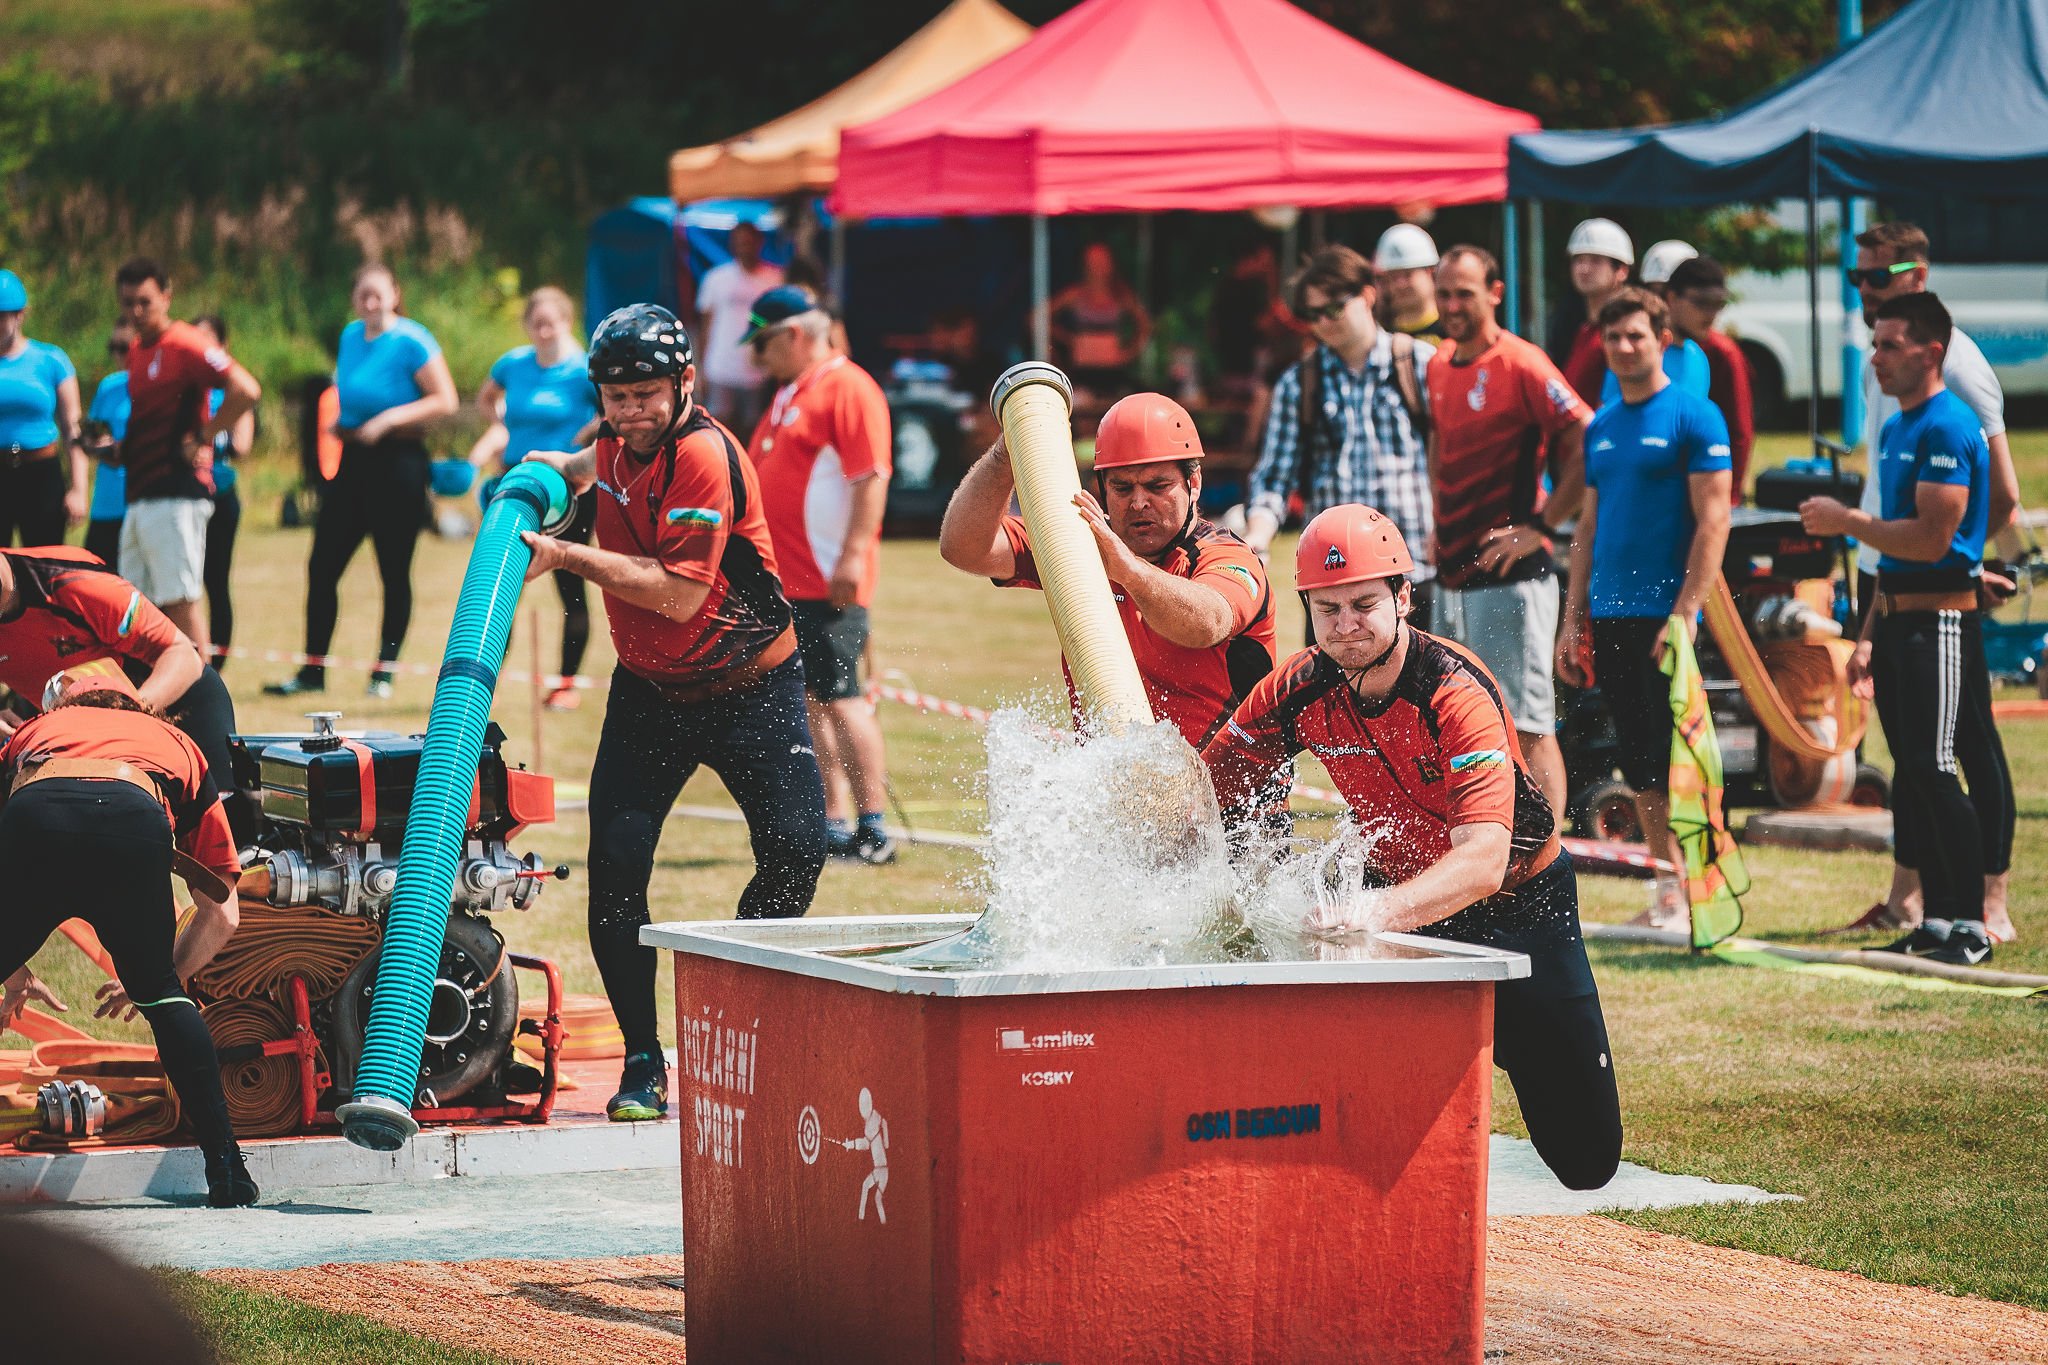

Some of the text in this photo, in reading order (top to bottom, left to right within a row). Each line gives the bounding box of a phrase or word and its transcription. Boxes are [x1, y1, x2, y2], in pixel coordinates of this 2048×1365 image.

[1324, 561, 1347, 571] CAMP
[683, 1005, 760, 1096] POŽÁRNÍ
[1001, 1030, 1095, 1049] Lamitex
[1021, 1071, 1074, 1086] KOSKY
[694, 1096, 746, 1169] SPORT
[1235, 1103, 1321, 1139] BEROUN
